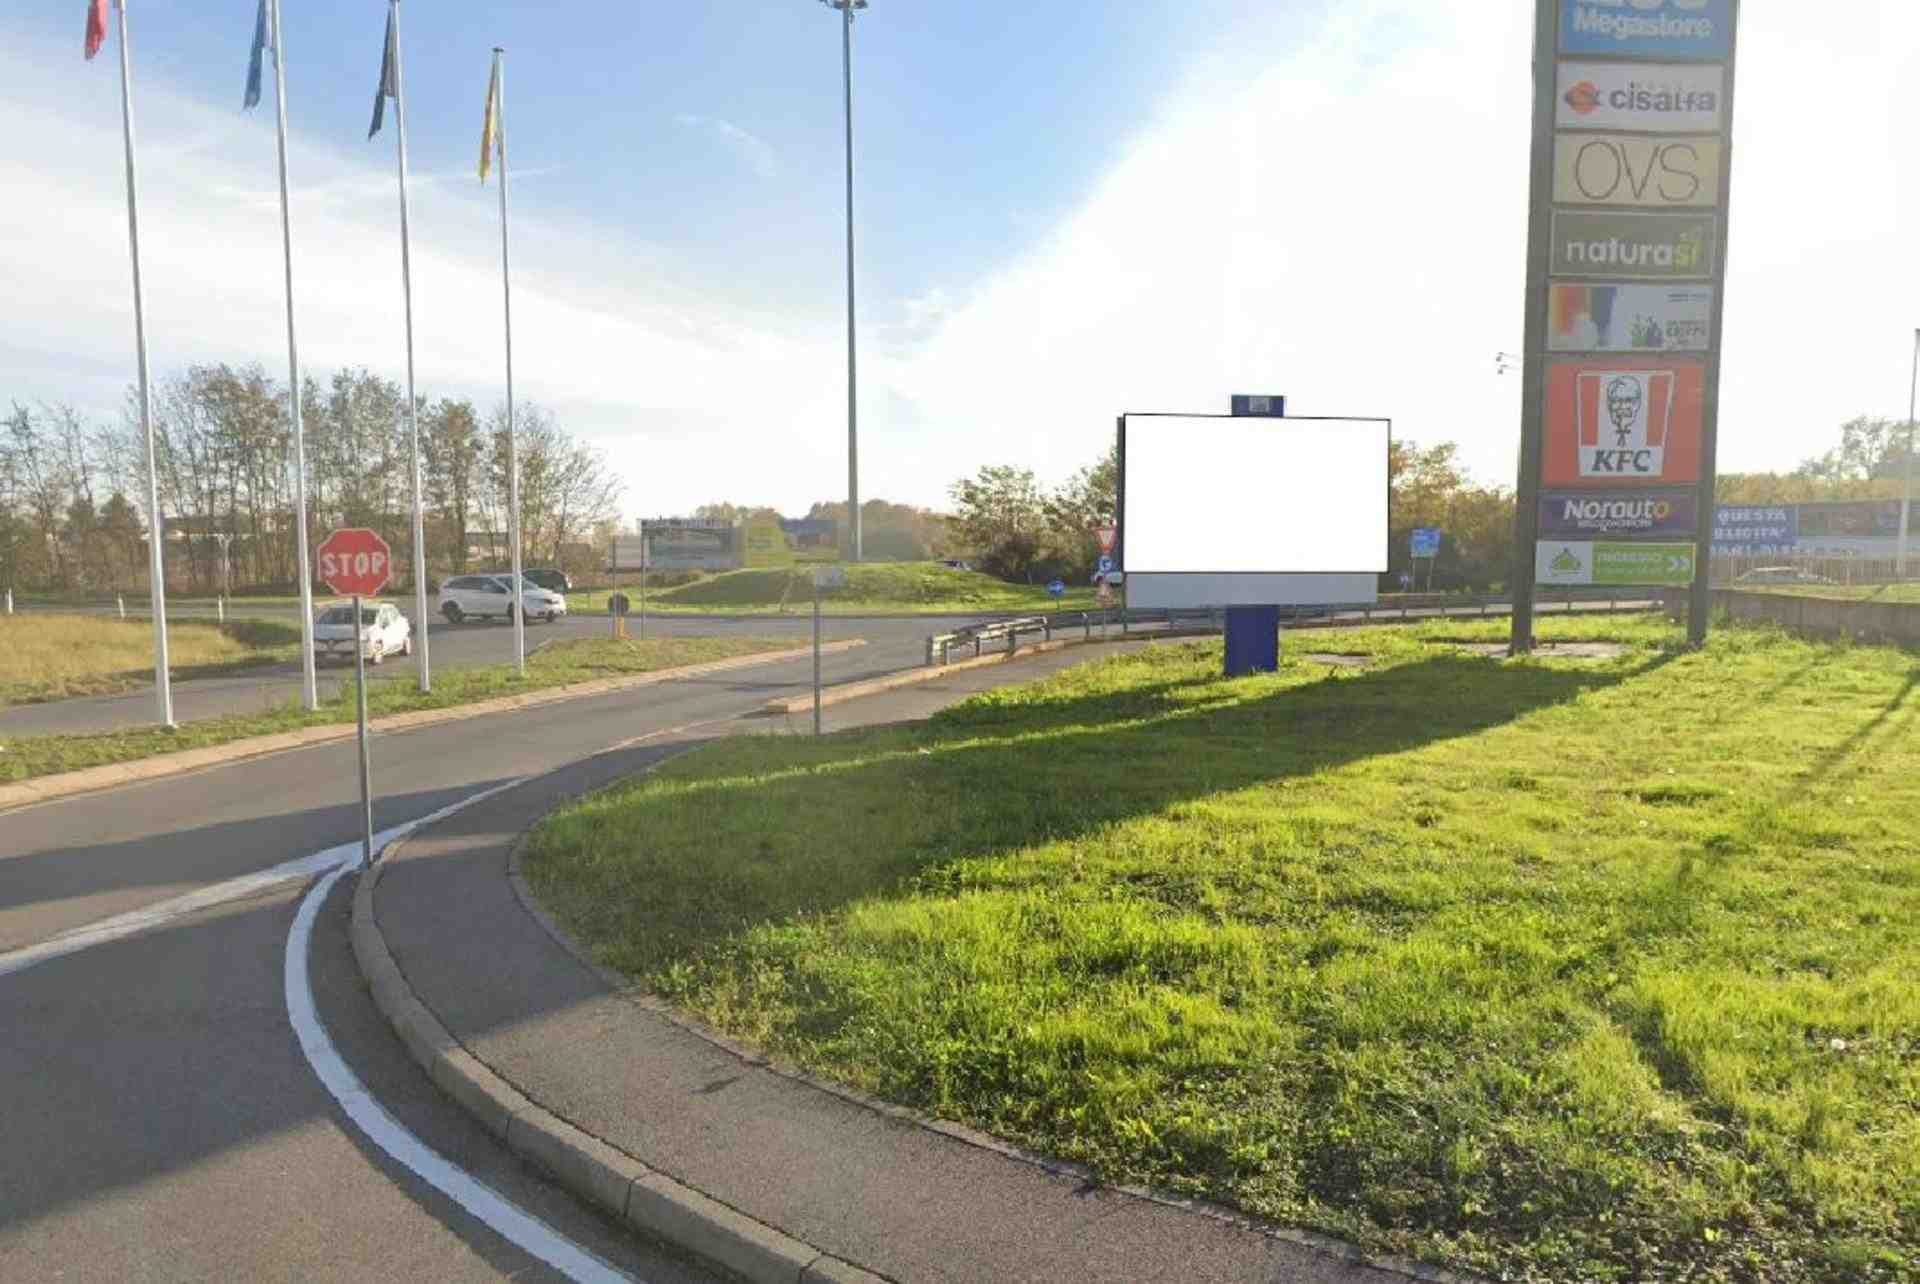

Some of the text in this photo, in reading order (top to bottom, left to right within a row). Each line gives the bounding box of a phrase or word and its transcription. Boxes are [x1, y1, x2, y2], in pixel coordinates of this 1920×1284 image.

[1574, 6, 1713, 39] Megastore
[1608, 81, 1716, 112] cisalfa
[1575, 141, 1700, 201] OVS
[1592, 449, 1651, 472] KFC
[1563, 499, 1671, 520] Norauto
[321, 552, 386, 577] STOP
